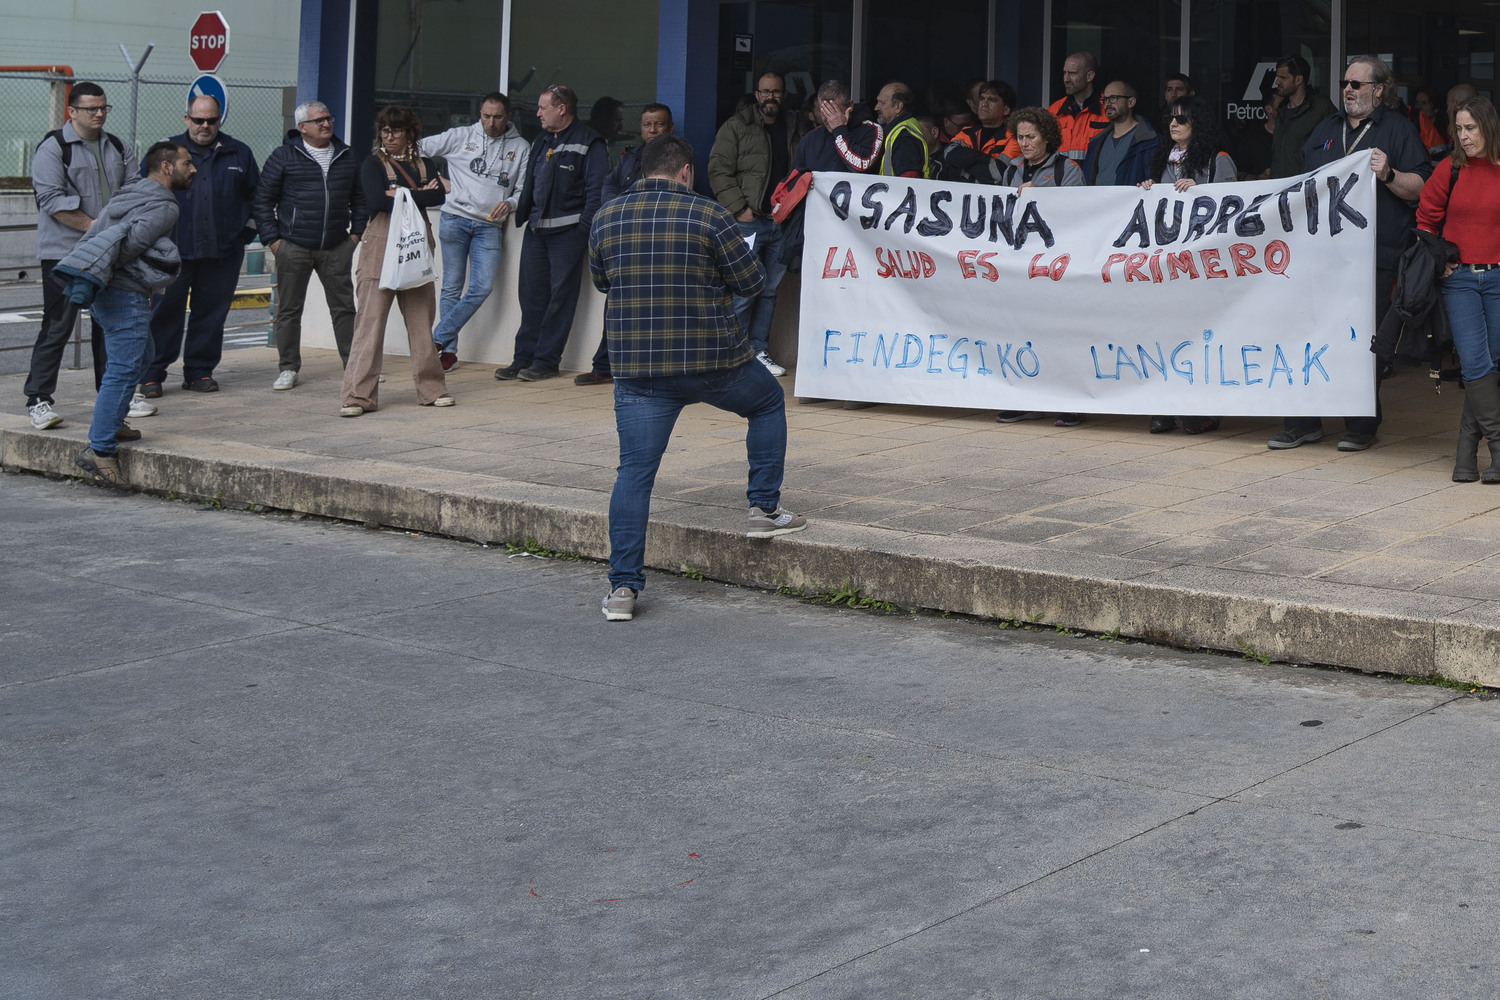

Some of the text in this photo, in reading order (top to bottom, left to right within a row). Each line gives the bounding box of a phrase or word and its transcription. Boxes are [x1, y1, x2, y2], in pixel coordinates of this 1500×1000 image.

[192, 35, 225, 49] STOP
[1227, 103, 1268, 120] Petro
[829, 180, 1055, 250] OSASUNA
[822, 246, 858, 280] LA
[876, 246, 936, 280] SALUD
[957, 250, 999, 282] ES
[1028, 252, 1071, 282] LO
[822, 329, 1040, 379] FINDEGIKO
